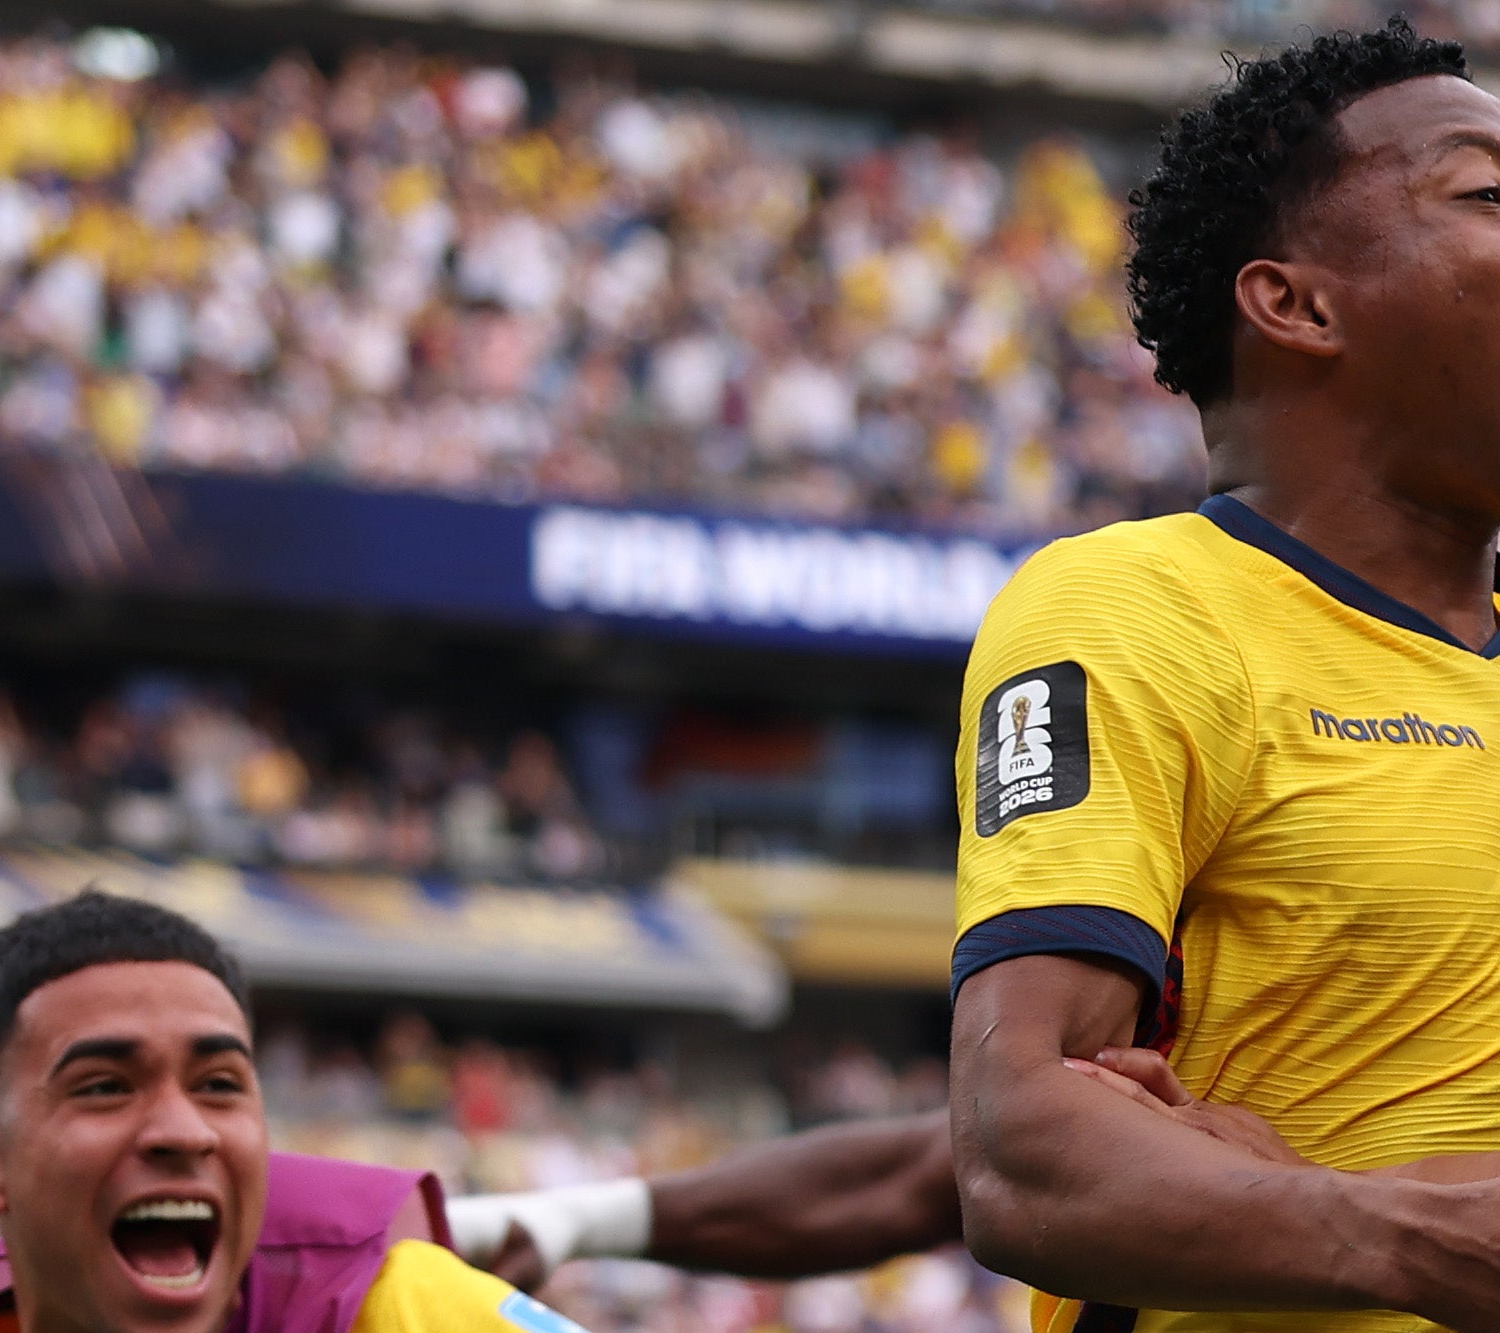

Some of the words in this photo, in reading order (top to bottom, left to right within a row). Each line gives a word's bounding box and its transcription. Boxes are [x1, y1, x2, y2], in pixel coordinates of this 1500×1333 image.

[1309, 708, 1486, 750] marathon
[1009, 757, 1035, 773] FIFA
[998, 780, 1029, 801] WORLD
[1029, 777, 1054, 789] CUP
[998, 787, 1054, 819] 2026
